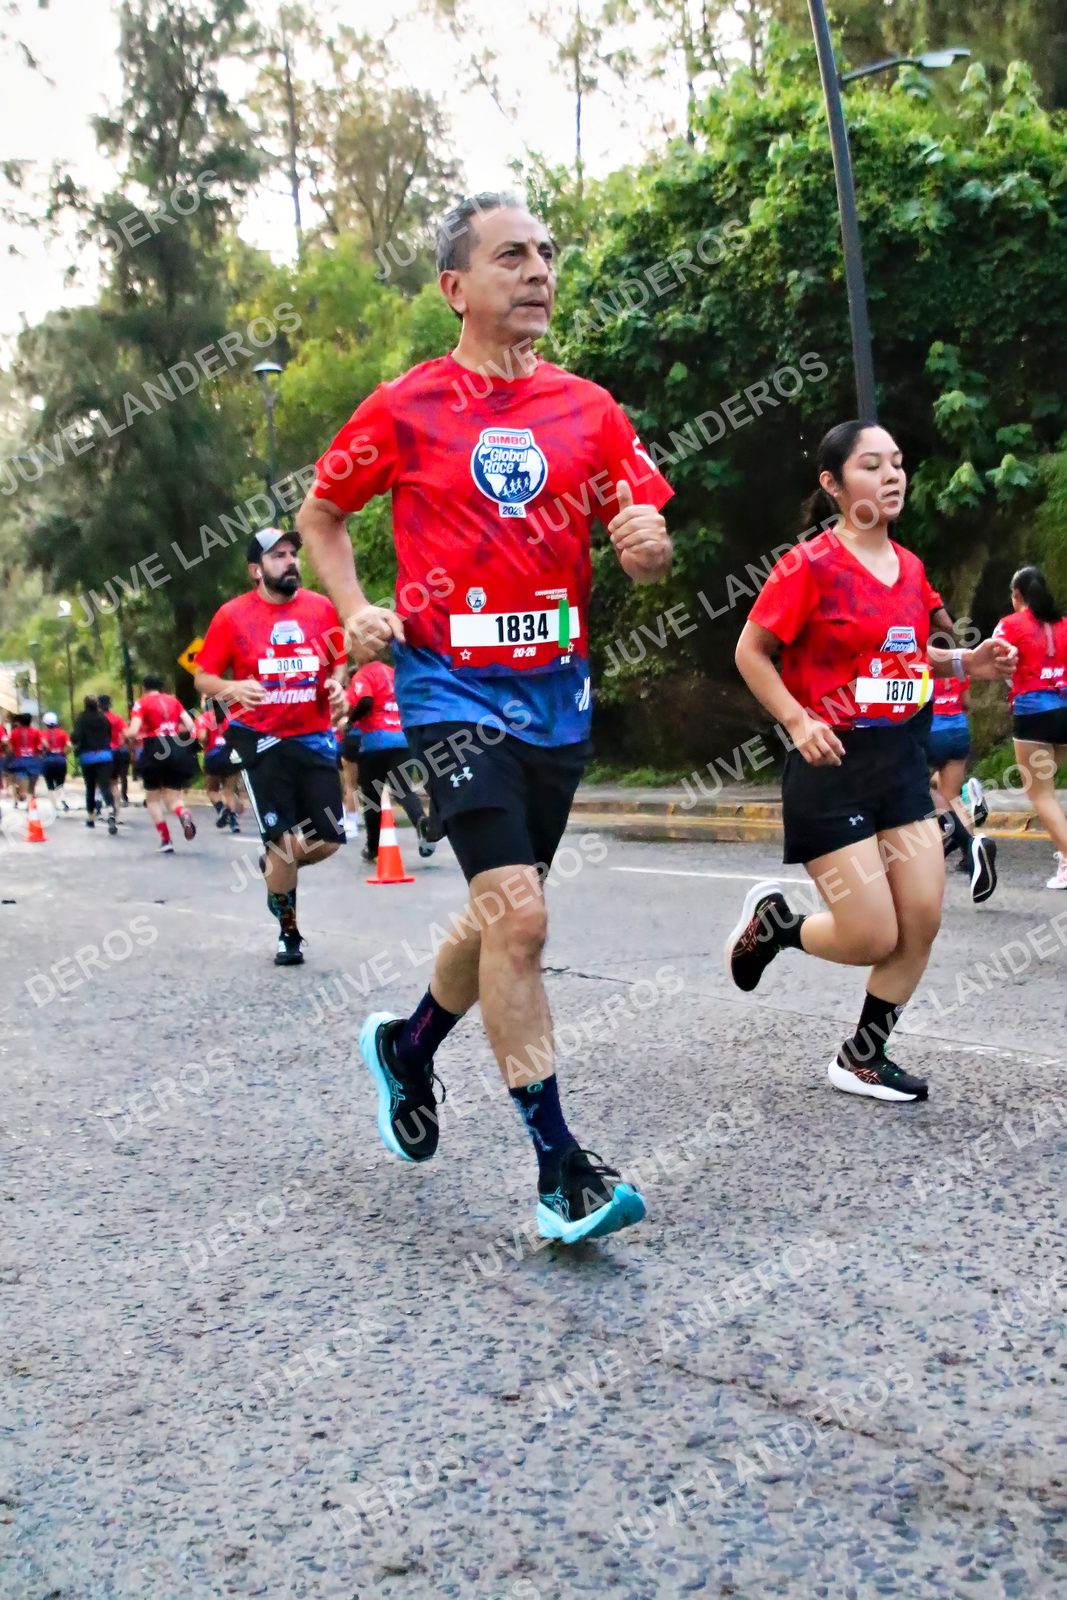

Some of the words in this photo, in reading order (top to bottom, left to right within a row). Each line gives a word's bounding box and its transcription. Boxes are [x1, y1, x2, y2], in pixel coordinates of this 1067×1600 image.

[488, 435, 527, 445] BIMBO
[489, 448, 528, 462] Global
[483, 460, 514, 474] Race
[495, 612, 548, 643] 1834
[277, 659, 303, 671] 3040
[886, 681, 914, 702] 1870
